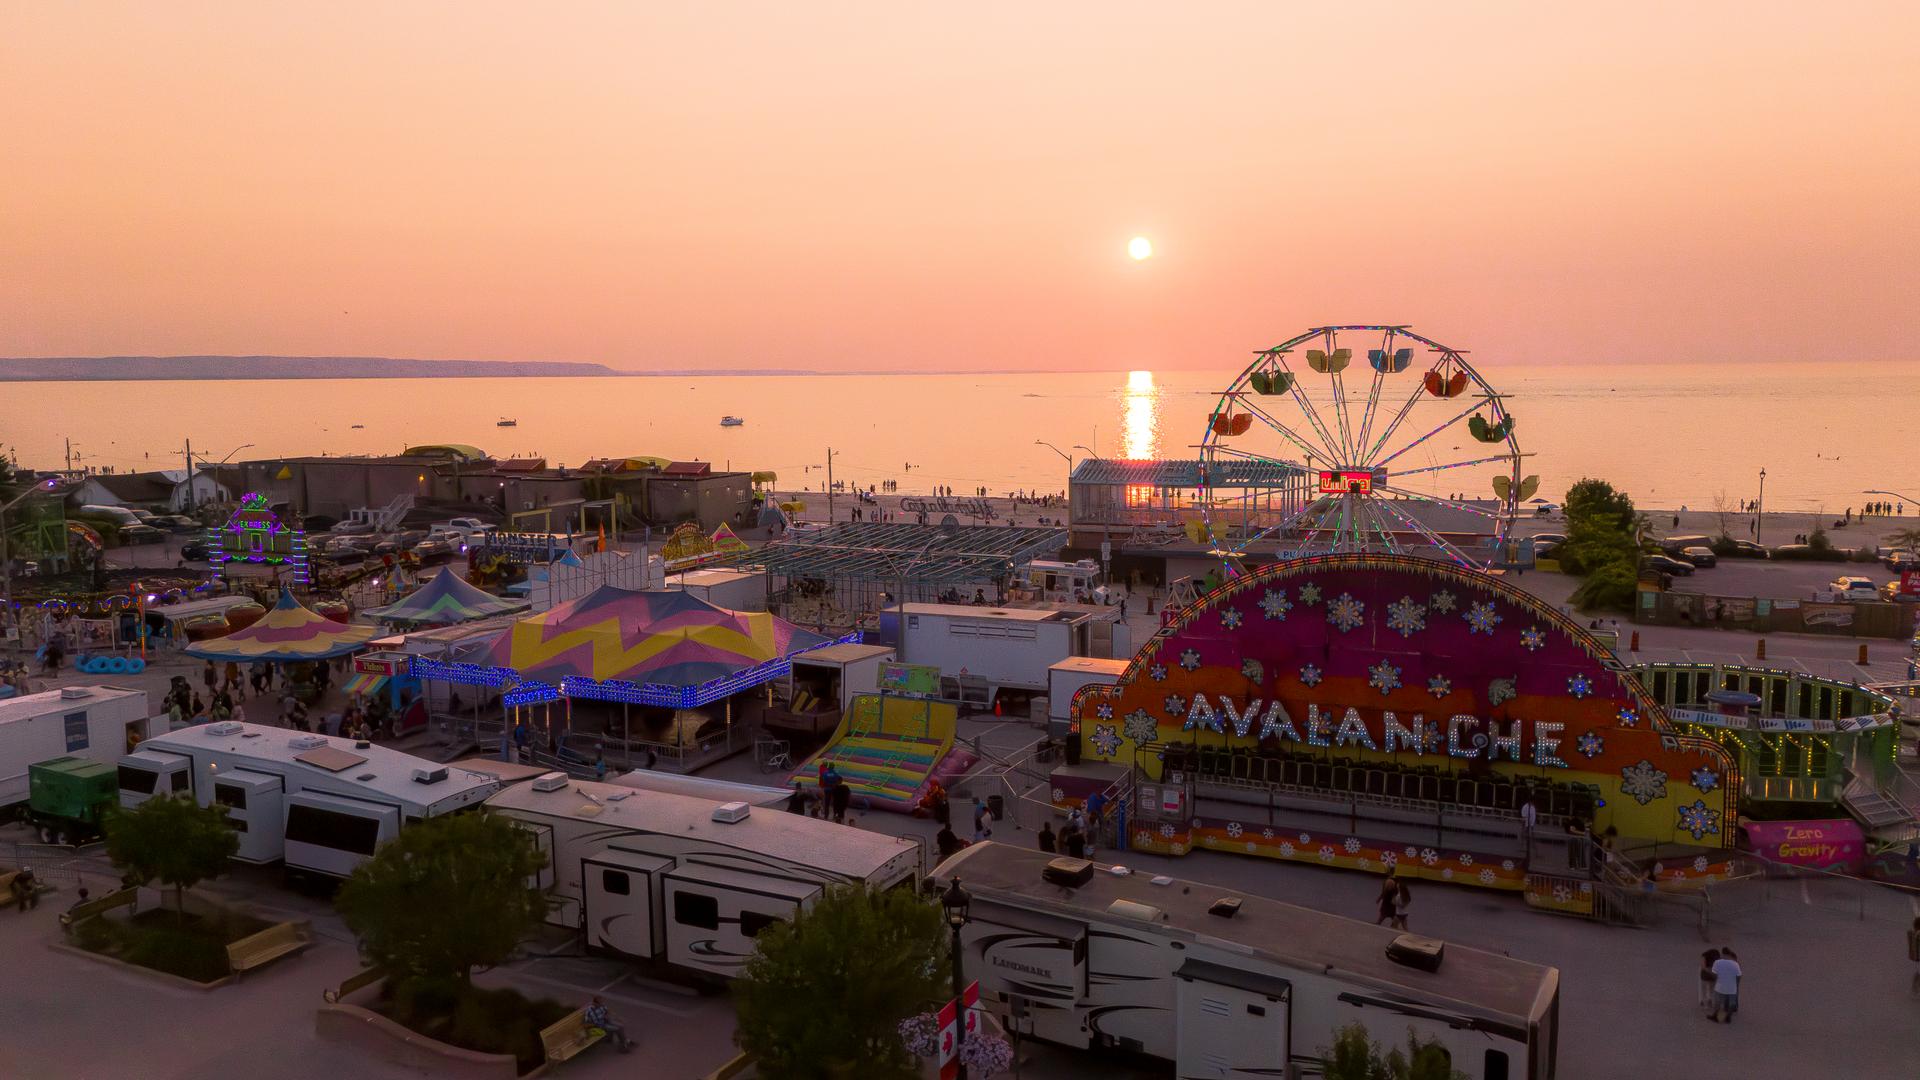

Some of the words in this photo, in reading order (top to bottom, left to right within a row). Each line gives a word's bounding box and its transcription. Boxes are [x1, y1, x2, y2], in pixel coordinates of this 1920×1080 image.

[240, 520, 271, 529] EXPRESS
[485, 532, 557, 546] MONSTER
[1283, 551, 1318, 559] PULIC
[1183, 693, 1568, 768] AVALANCHE
[1784, 826, 1824, 840] Zero
[1779, 843, 1838, 859] Gravity
